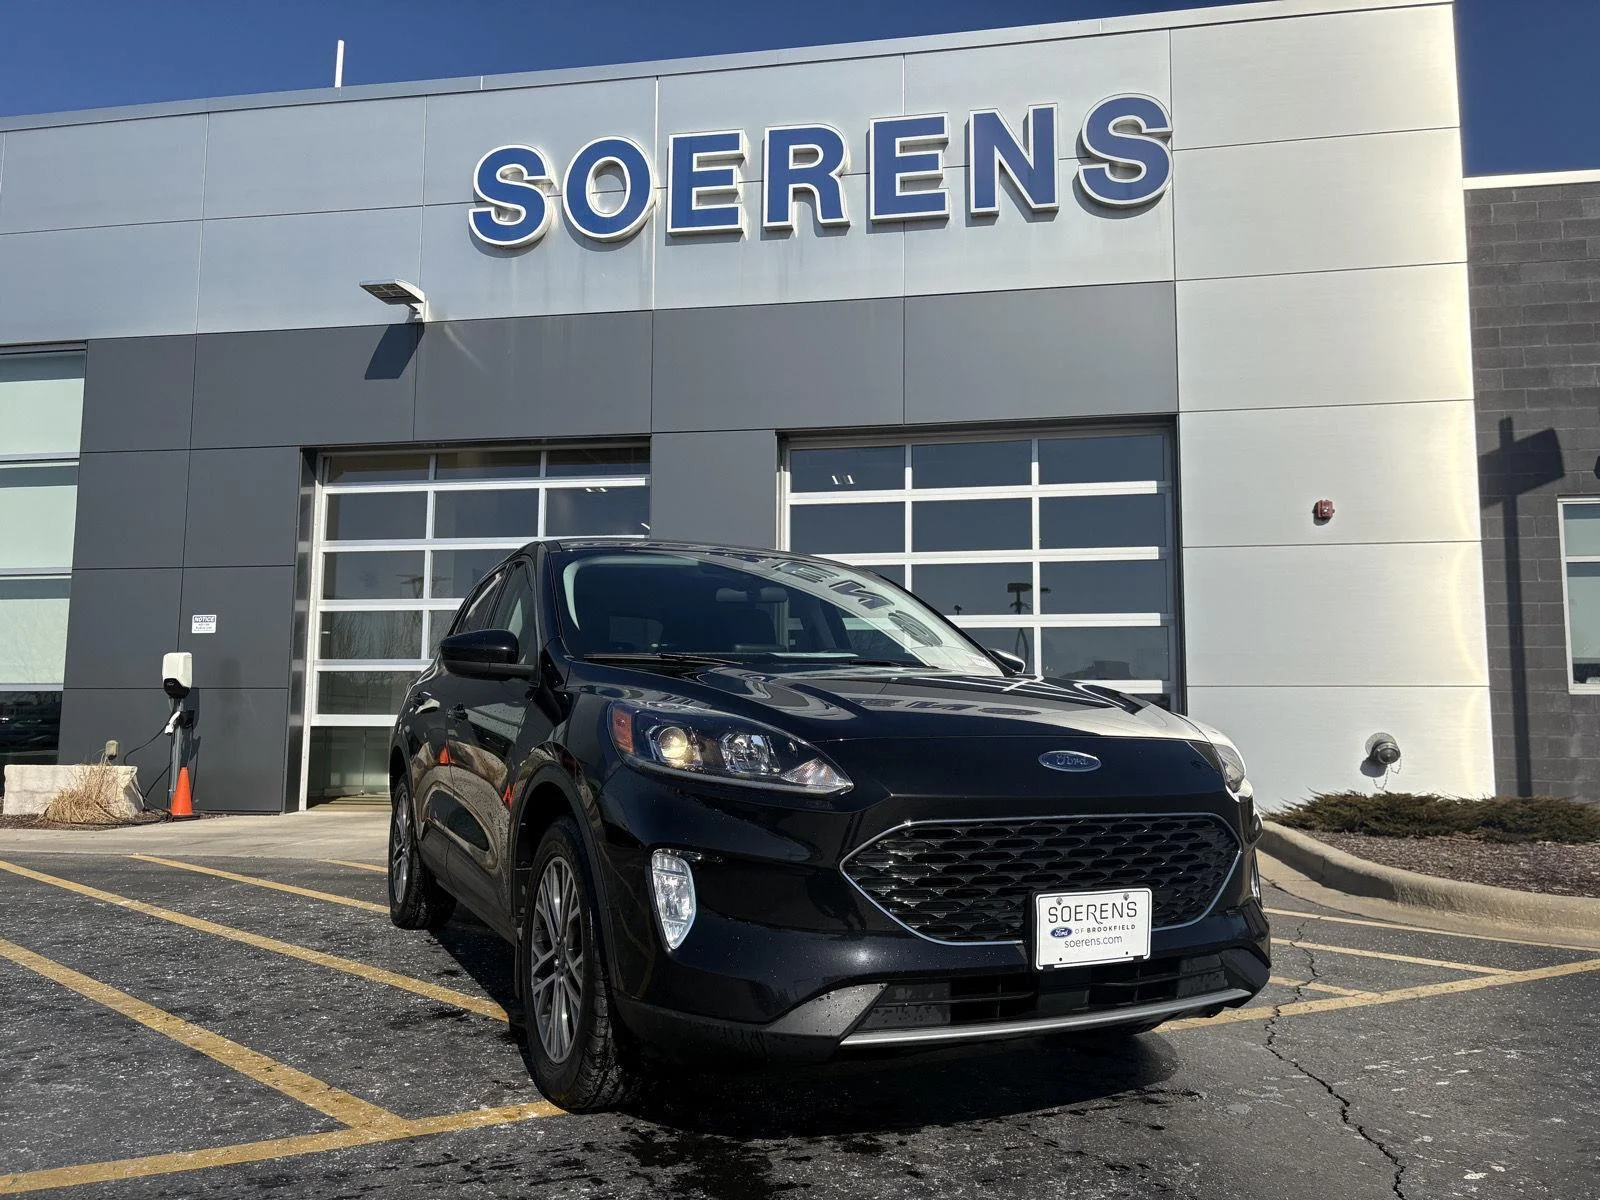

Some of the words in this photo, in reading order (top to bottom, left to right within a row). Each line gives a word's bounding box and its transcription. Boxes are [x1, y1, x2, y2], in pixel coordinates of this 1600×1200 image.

[469, 93, 1174, 249] SOERENS
[1048, 901, 1137, 924] SOERENS
[1086, 924, 1136, 933] BROOKFIELD
[1064, 935, 1123, 948] soerens.com
